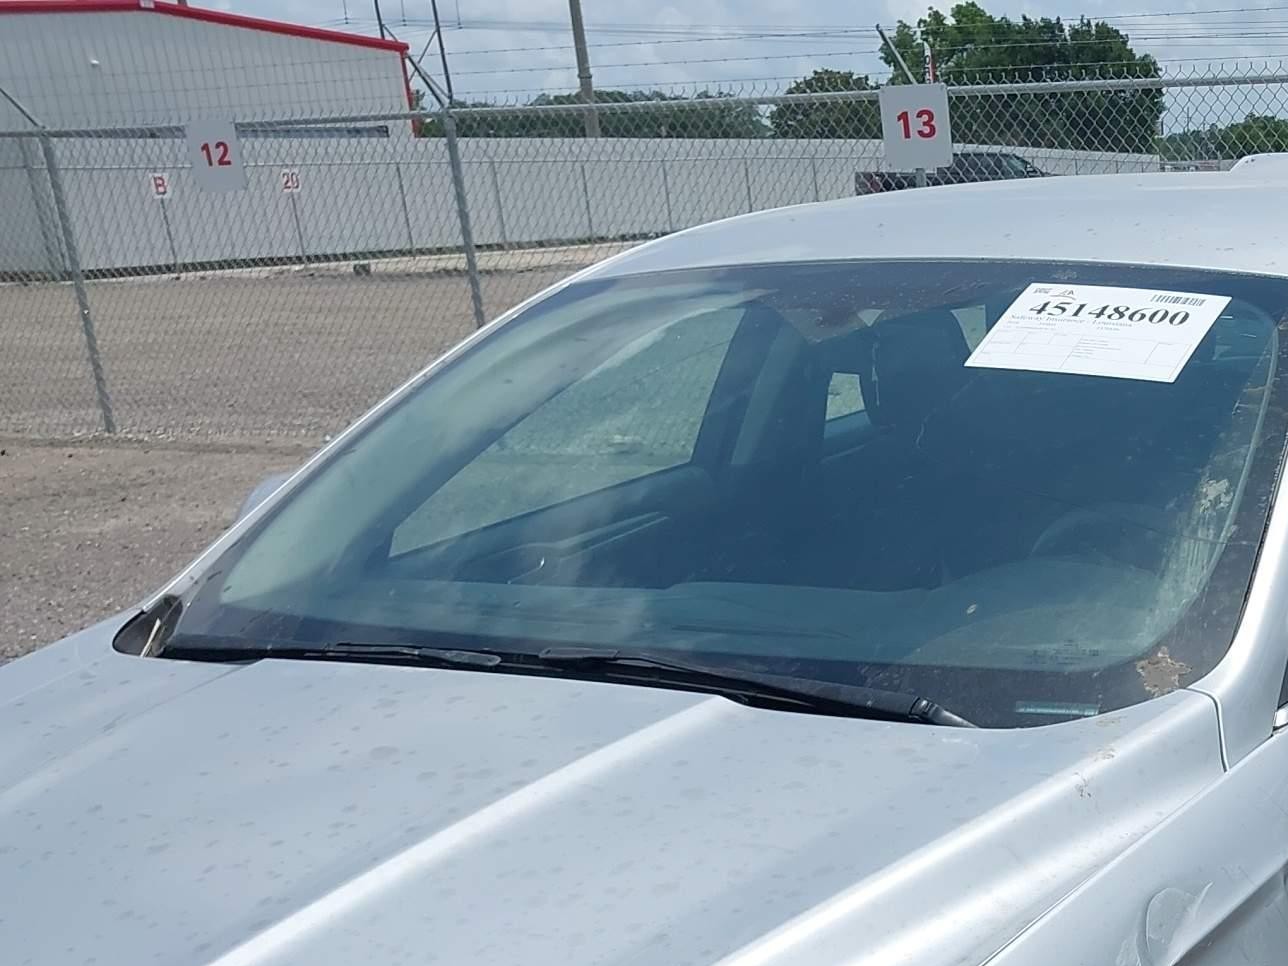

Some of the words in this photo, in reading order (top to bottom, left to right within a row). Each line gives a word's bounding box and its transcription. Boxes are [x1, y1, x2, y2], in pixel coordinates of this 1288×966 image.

[896, 109, 937, 139] 13
[200, 141, 232, 167] 12
[1028, 300, 1190, 327] 45148600
